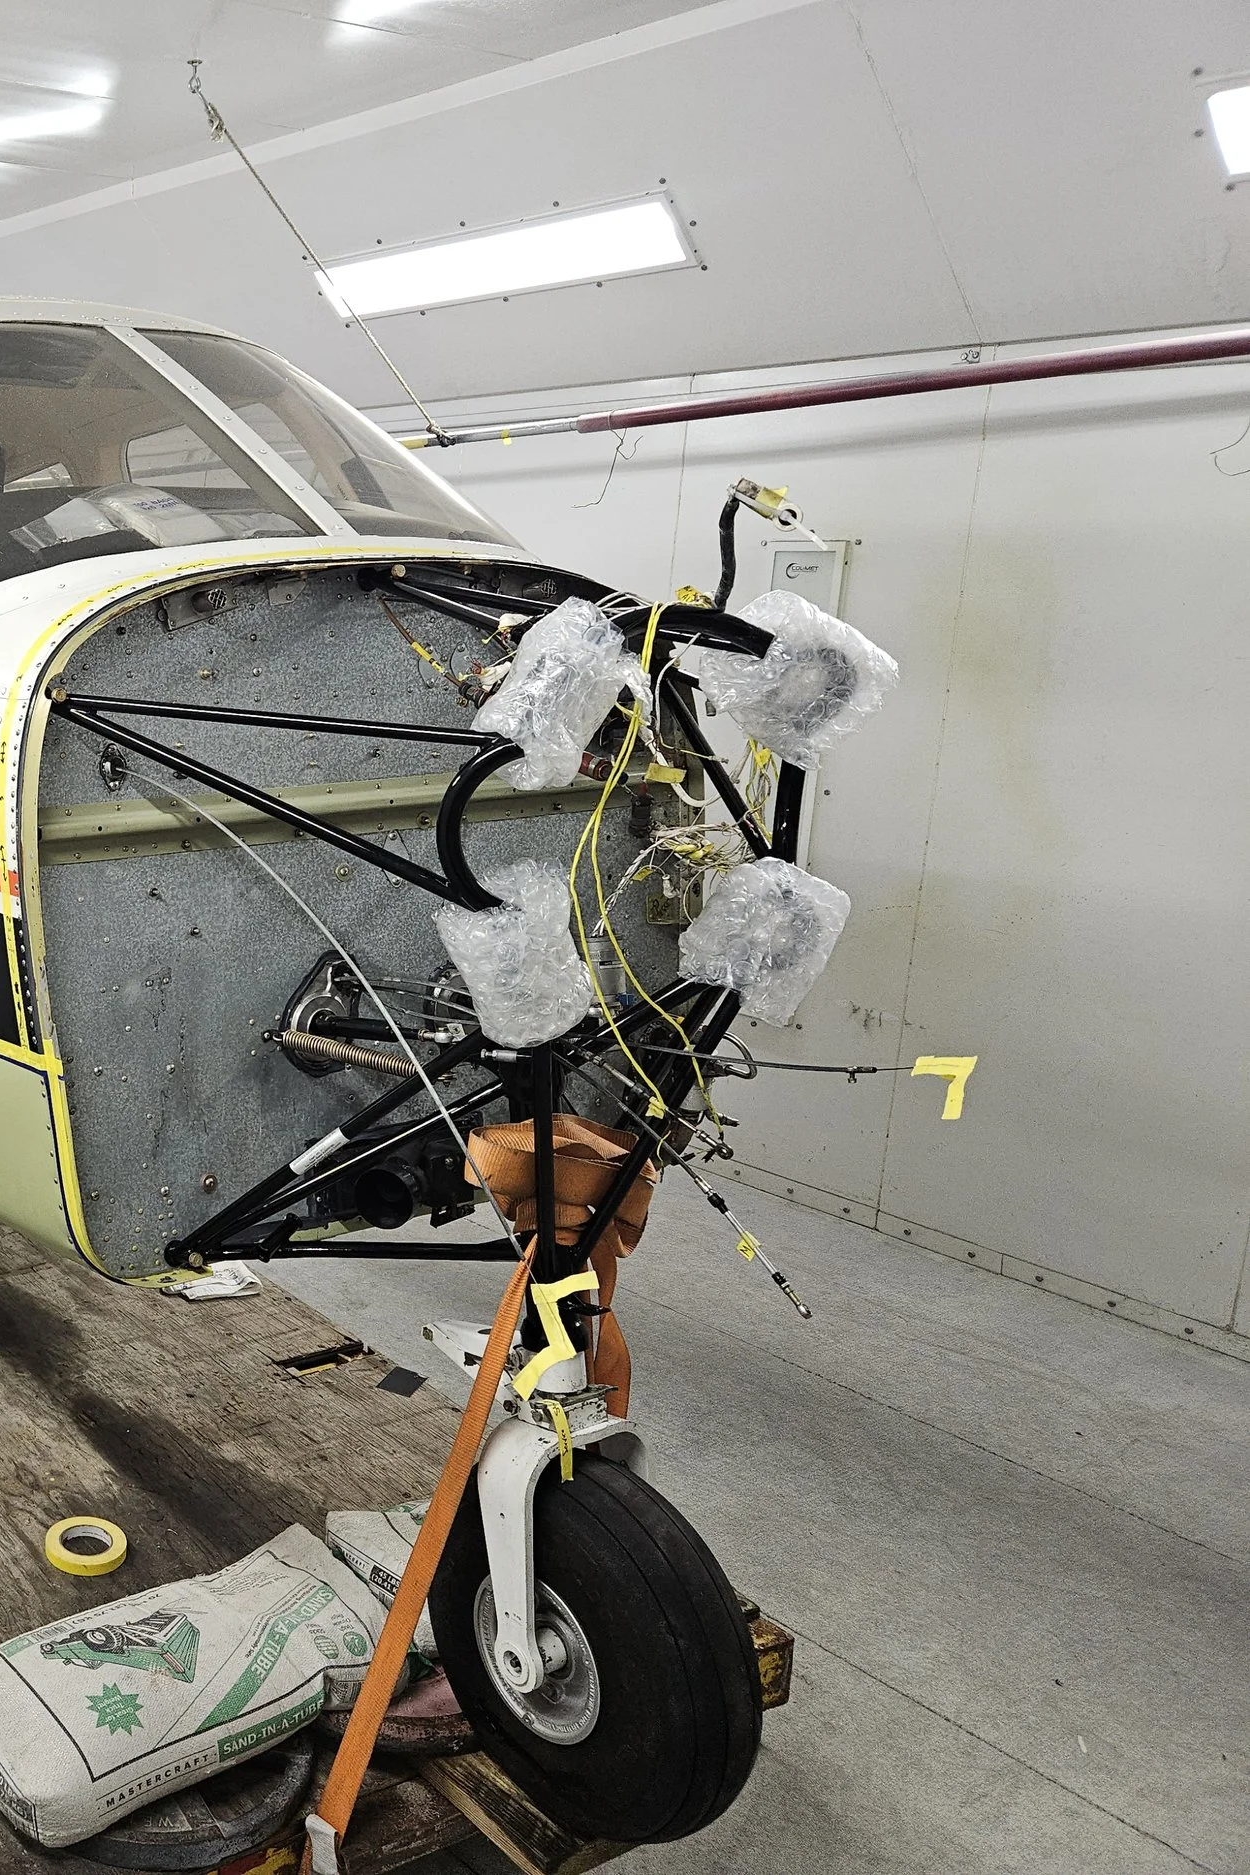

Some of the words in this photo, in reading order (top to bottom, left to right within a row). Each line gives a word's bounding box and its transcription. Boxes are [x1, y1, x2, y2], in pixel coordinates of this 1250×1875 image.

[379, 1570, 388, 1579] 45
[388, 1575, 402, 1588] LBS
[105, 1701, 124, 1715] Truck
[115, 1706, 134, 1719] Great
[104, 1714, 115, 1724] for
[223, 1699, 325, 1755] SAND-IN-A-TUBE
[106, 1753, 210, 1809] MASTERCRAFT
